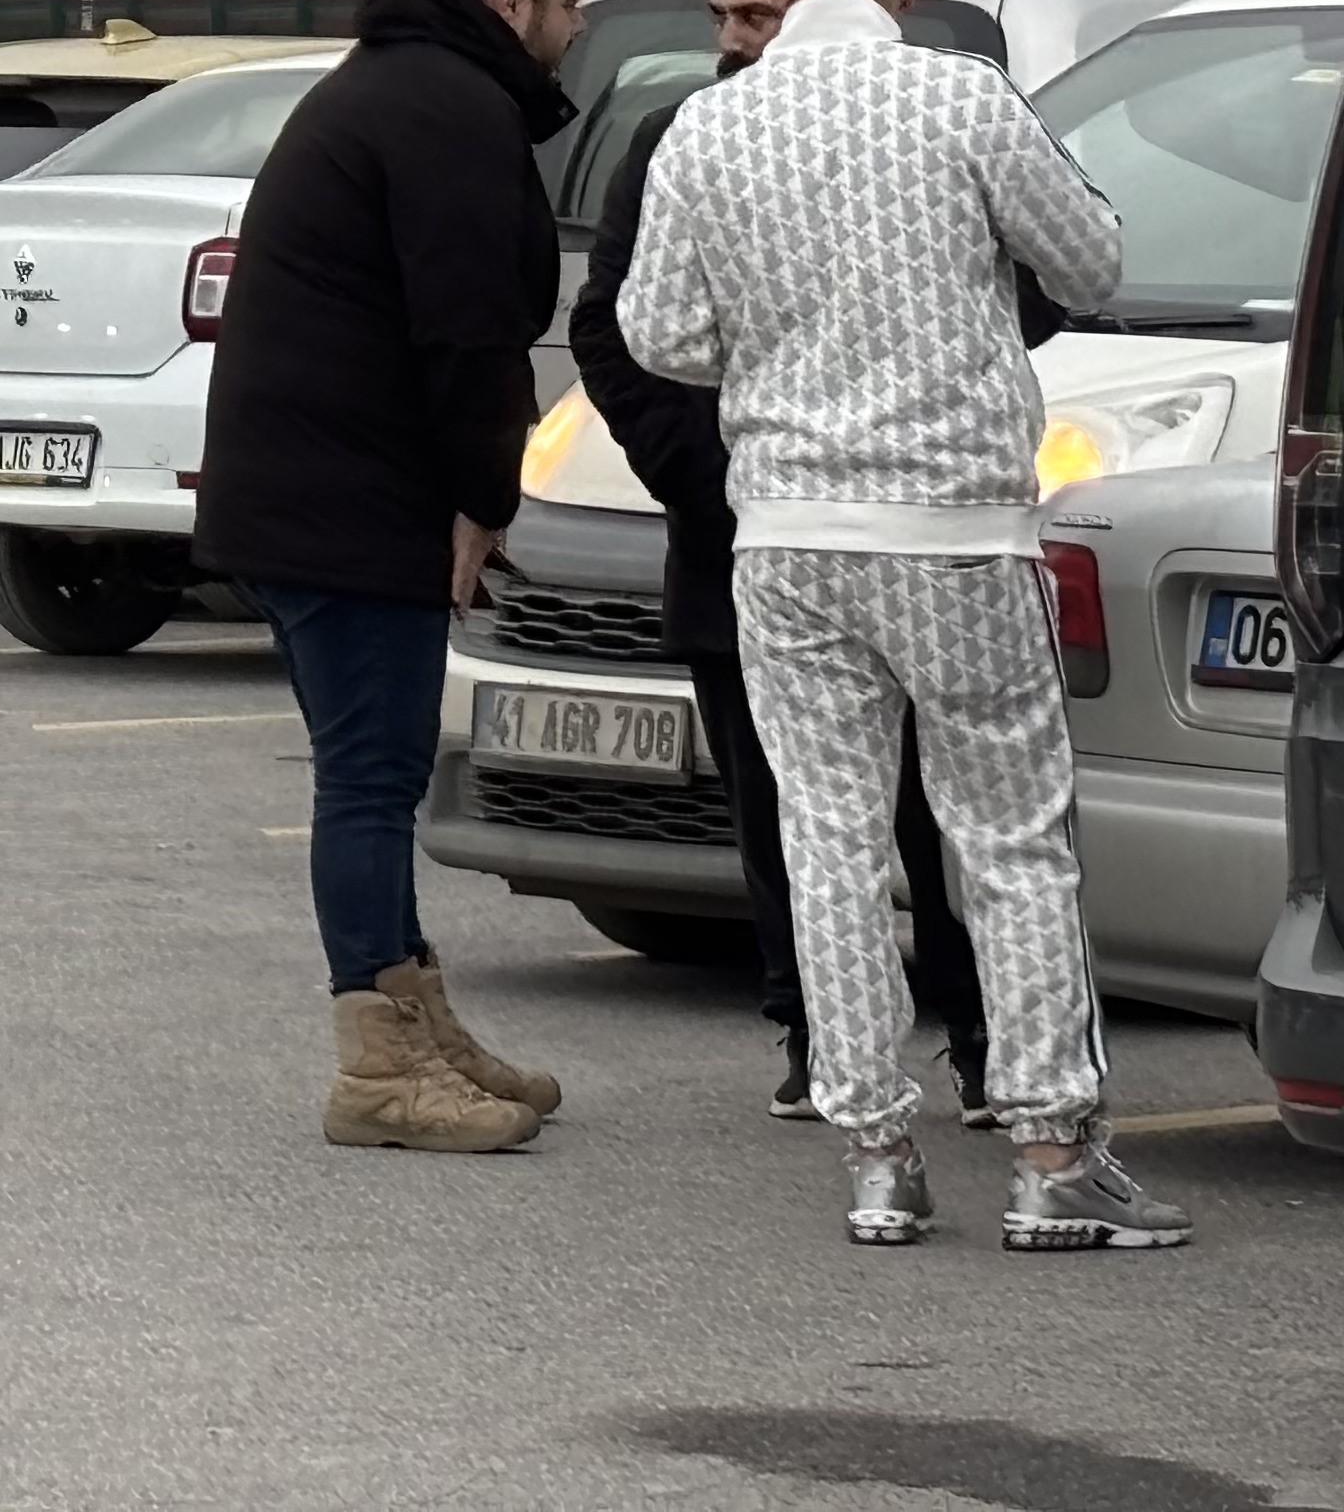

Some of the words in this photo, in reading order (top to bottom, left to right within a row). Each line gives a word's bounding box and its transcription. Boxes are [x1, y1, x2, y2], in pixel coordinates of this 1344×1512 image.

[43, 437, 84, 473] 634
[1232, 604, 1288, 667] 06
[493, 693, 525, 751] 41
[541, 700, 600, 754] AGR
[612, 705, 676, 763] 708
